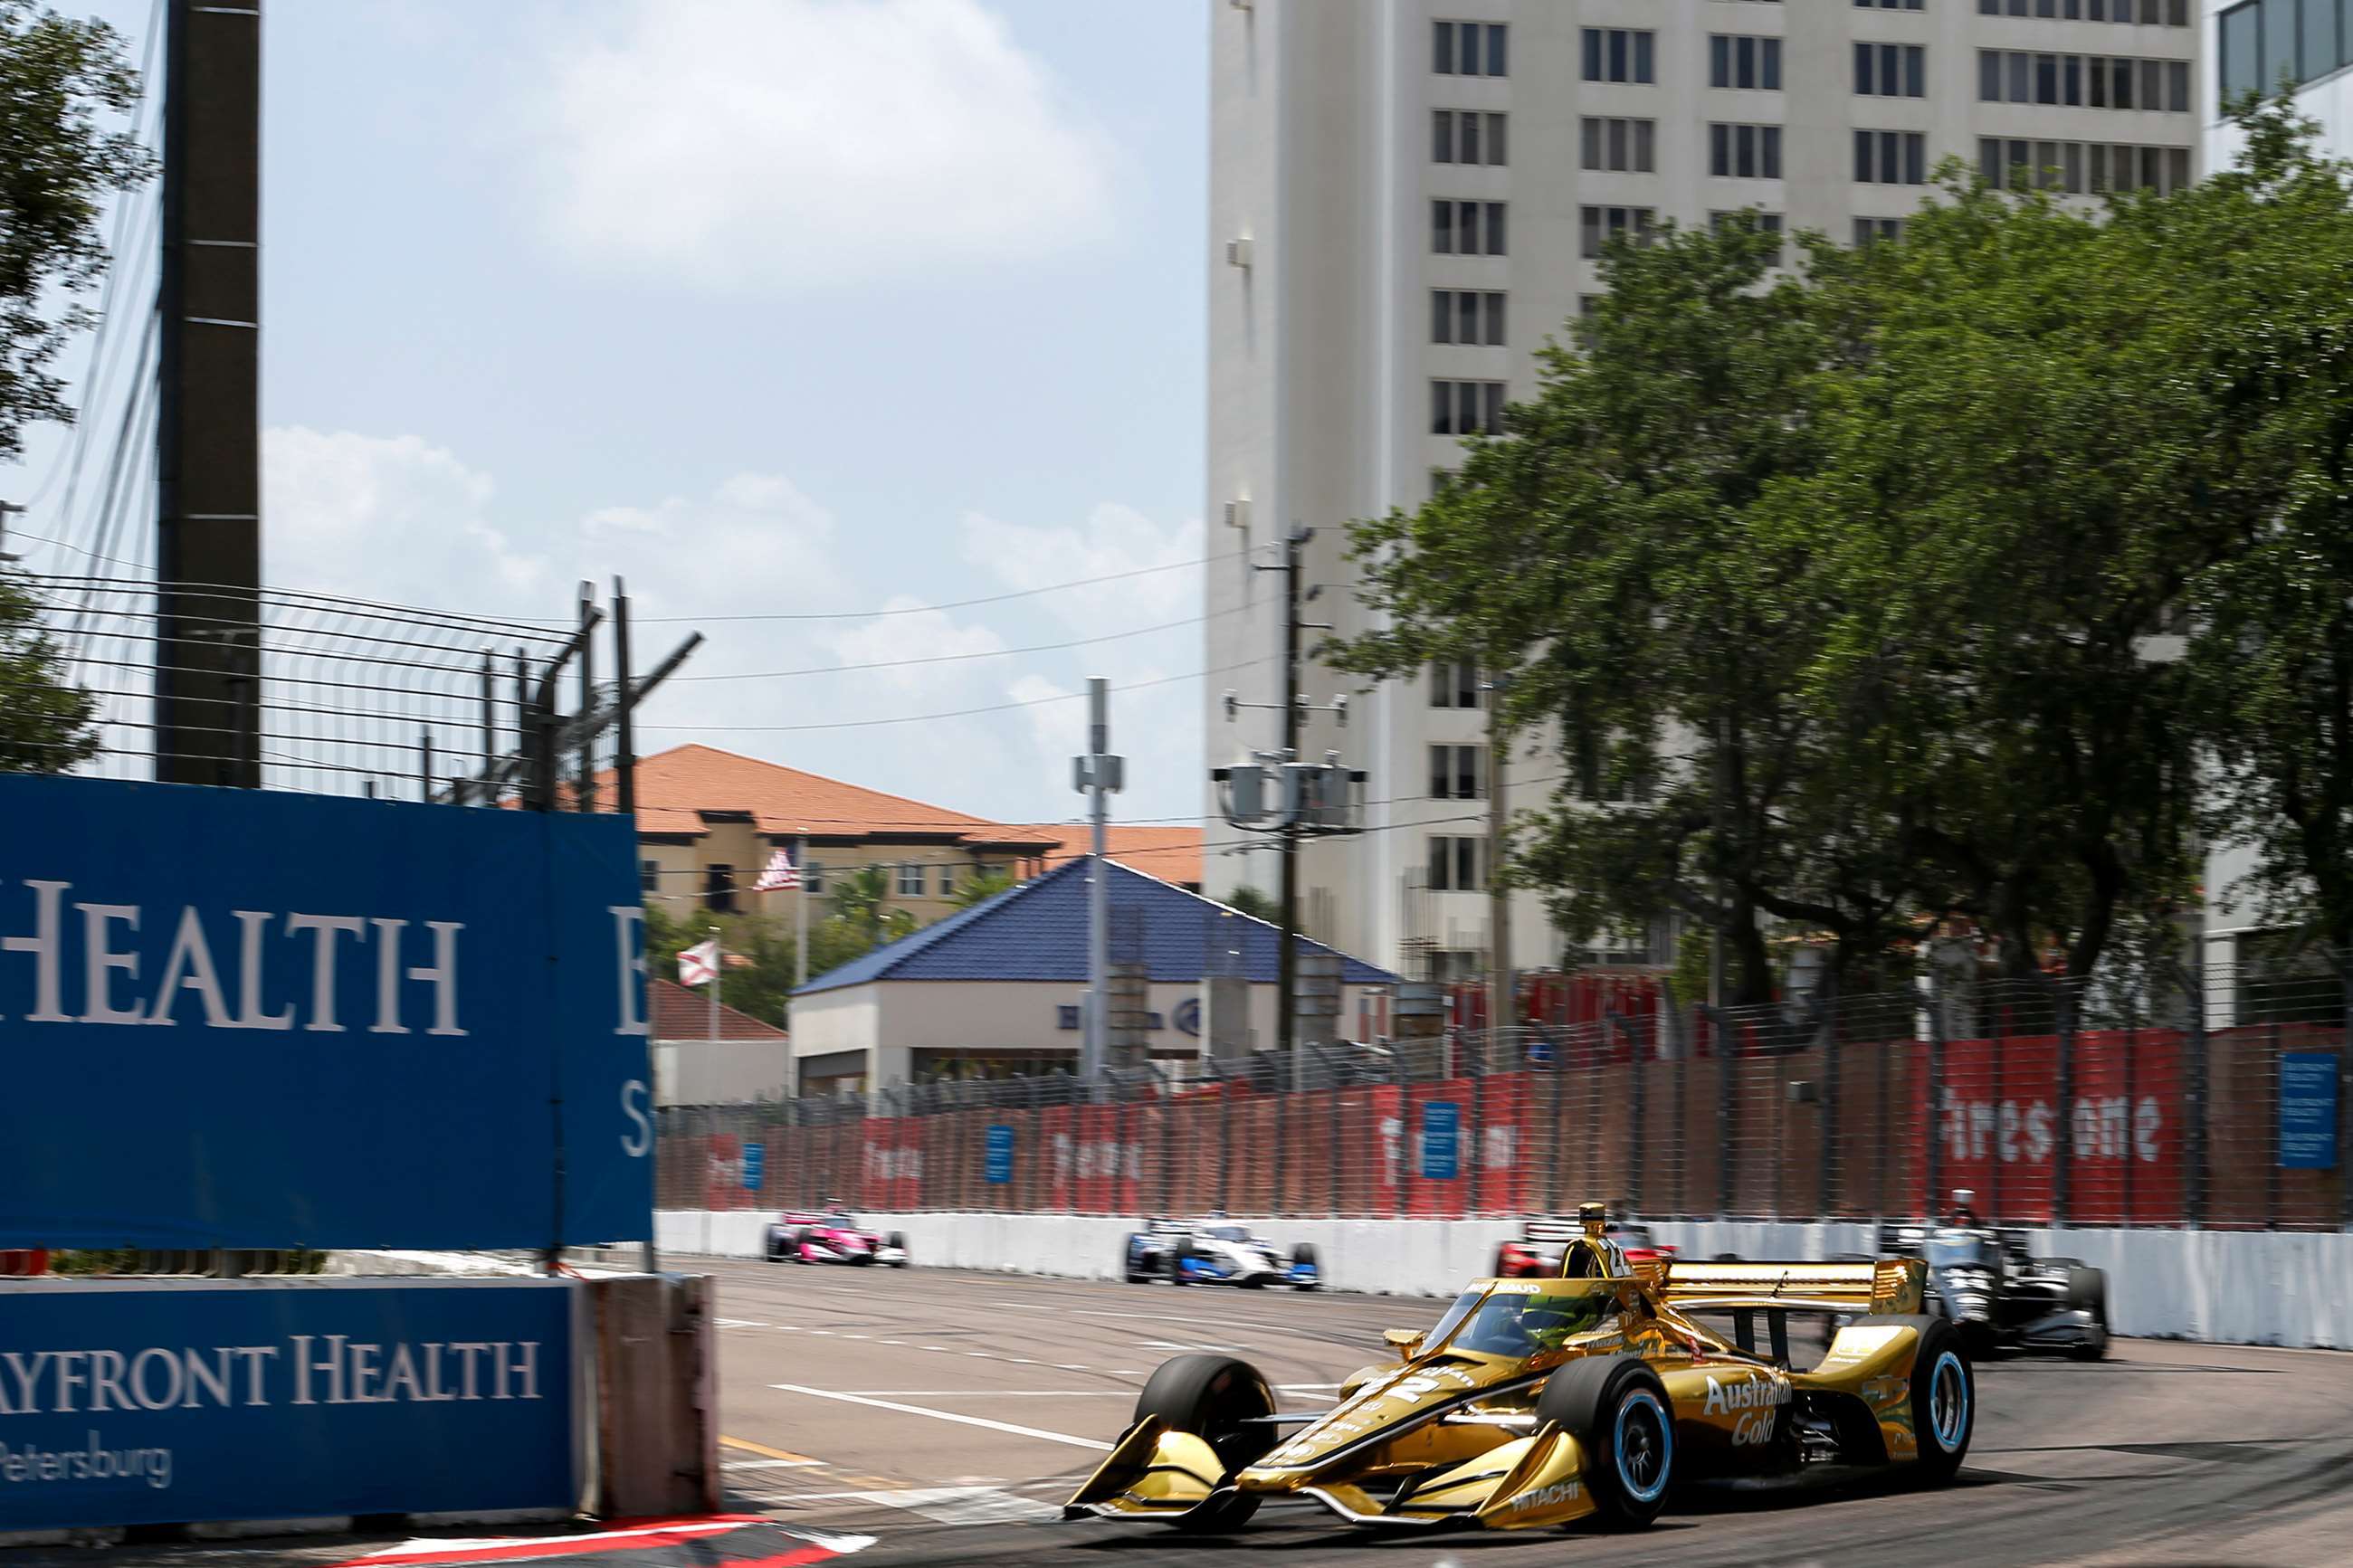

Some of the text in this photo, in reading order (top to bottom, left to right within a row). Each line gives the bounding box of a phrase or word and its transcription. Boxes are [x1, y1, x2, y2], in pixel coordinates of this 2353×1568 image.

[0, 879, 470, 1037] HEALTH
[289, 1335, 544, 1404] HEALTH
[1703, 1373, 1792, 1415] Australian
[1731, 1410, 1777, 1446] Gold
[1511, 1482, 1578, 1513] HITACHI
